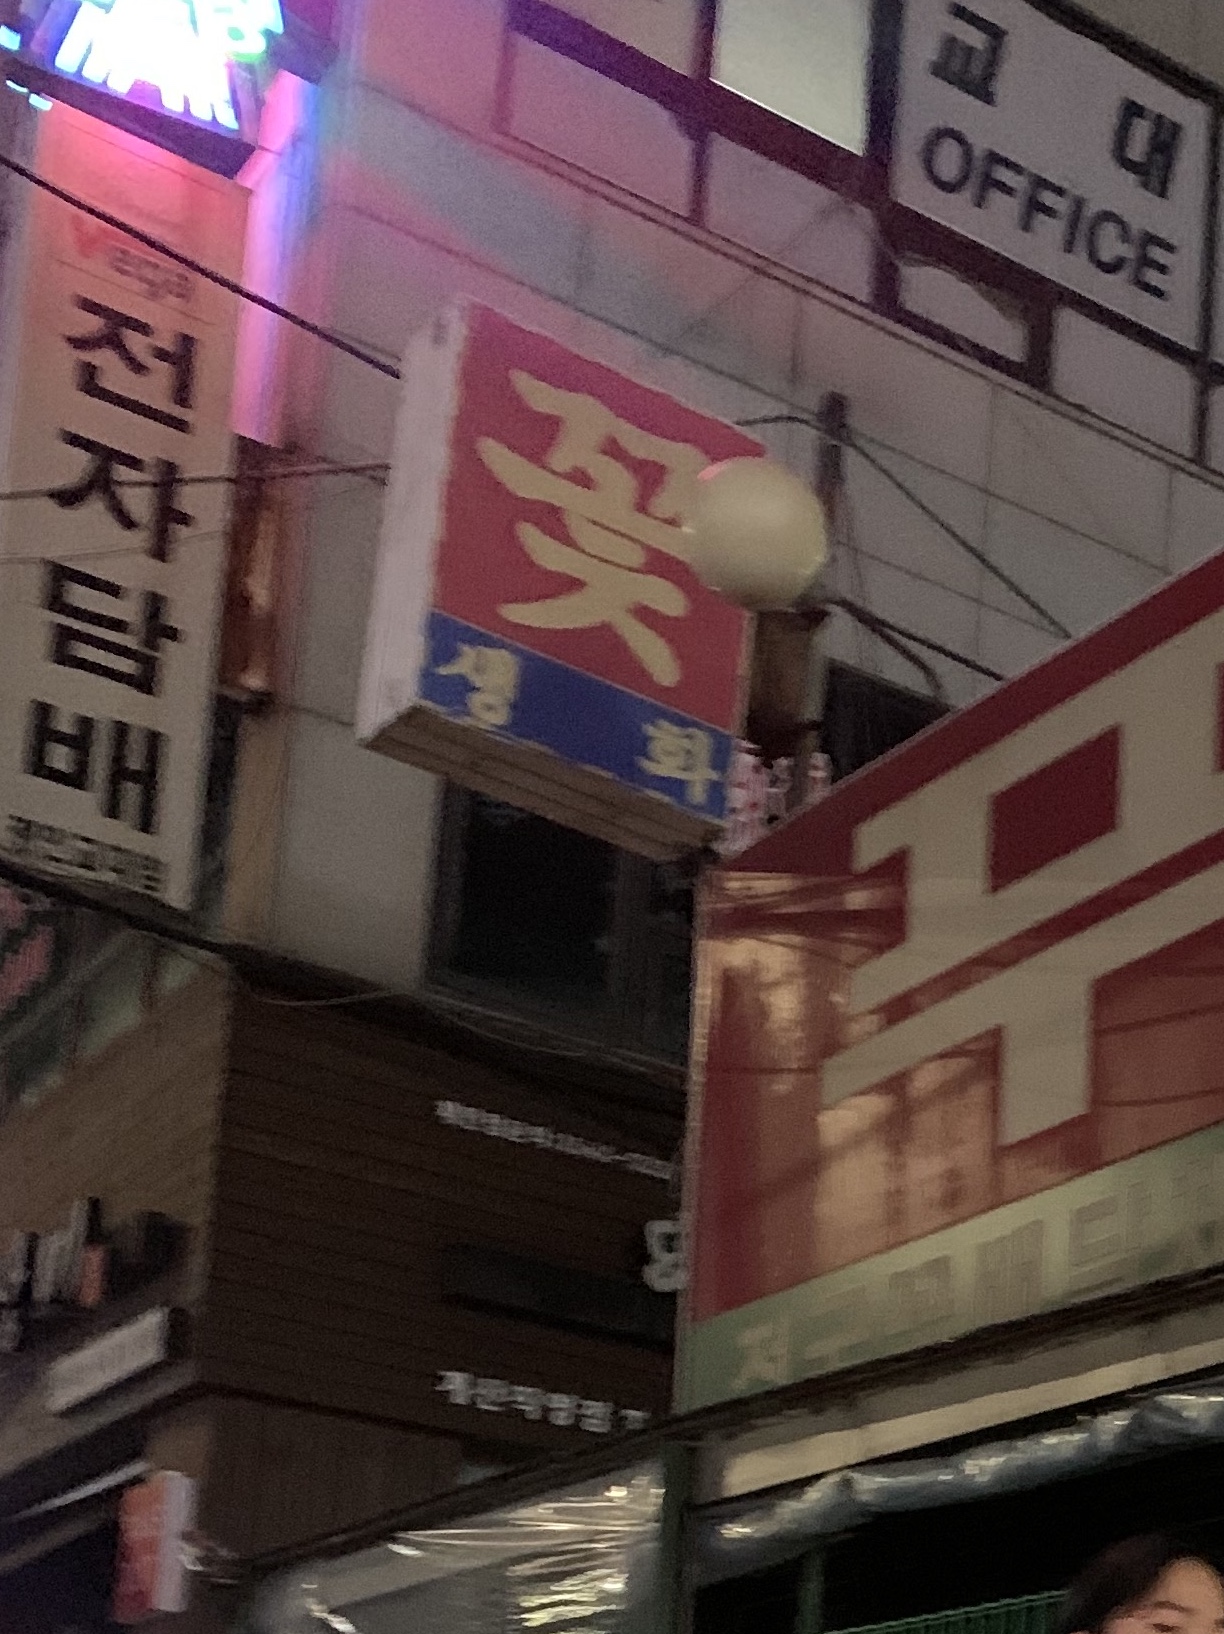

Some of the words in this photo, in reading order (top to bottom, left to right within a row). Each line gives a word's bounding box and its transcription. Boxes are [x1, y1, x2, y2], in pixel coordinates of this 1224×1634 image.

[919, 124, 1178, 303] OFFICE
[22, 294, 200, 834] 전자담배
[476, 368, 706, 688] 꽃
